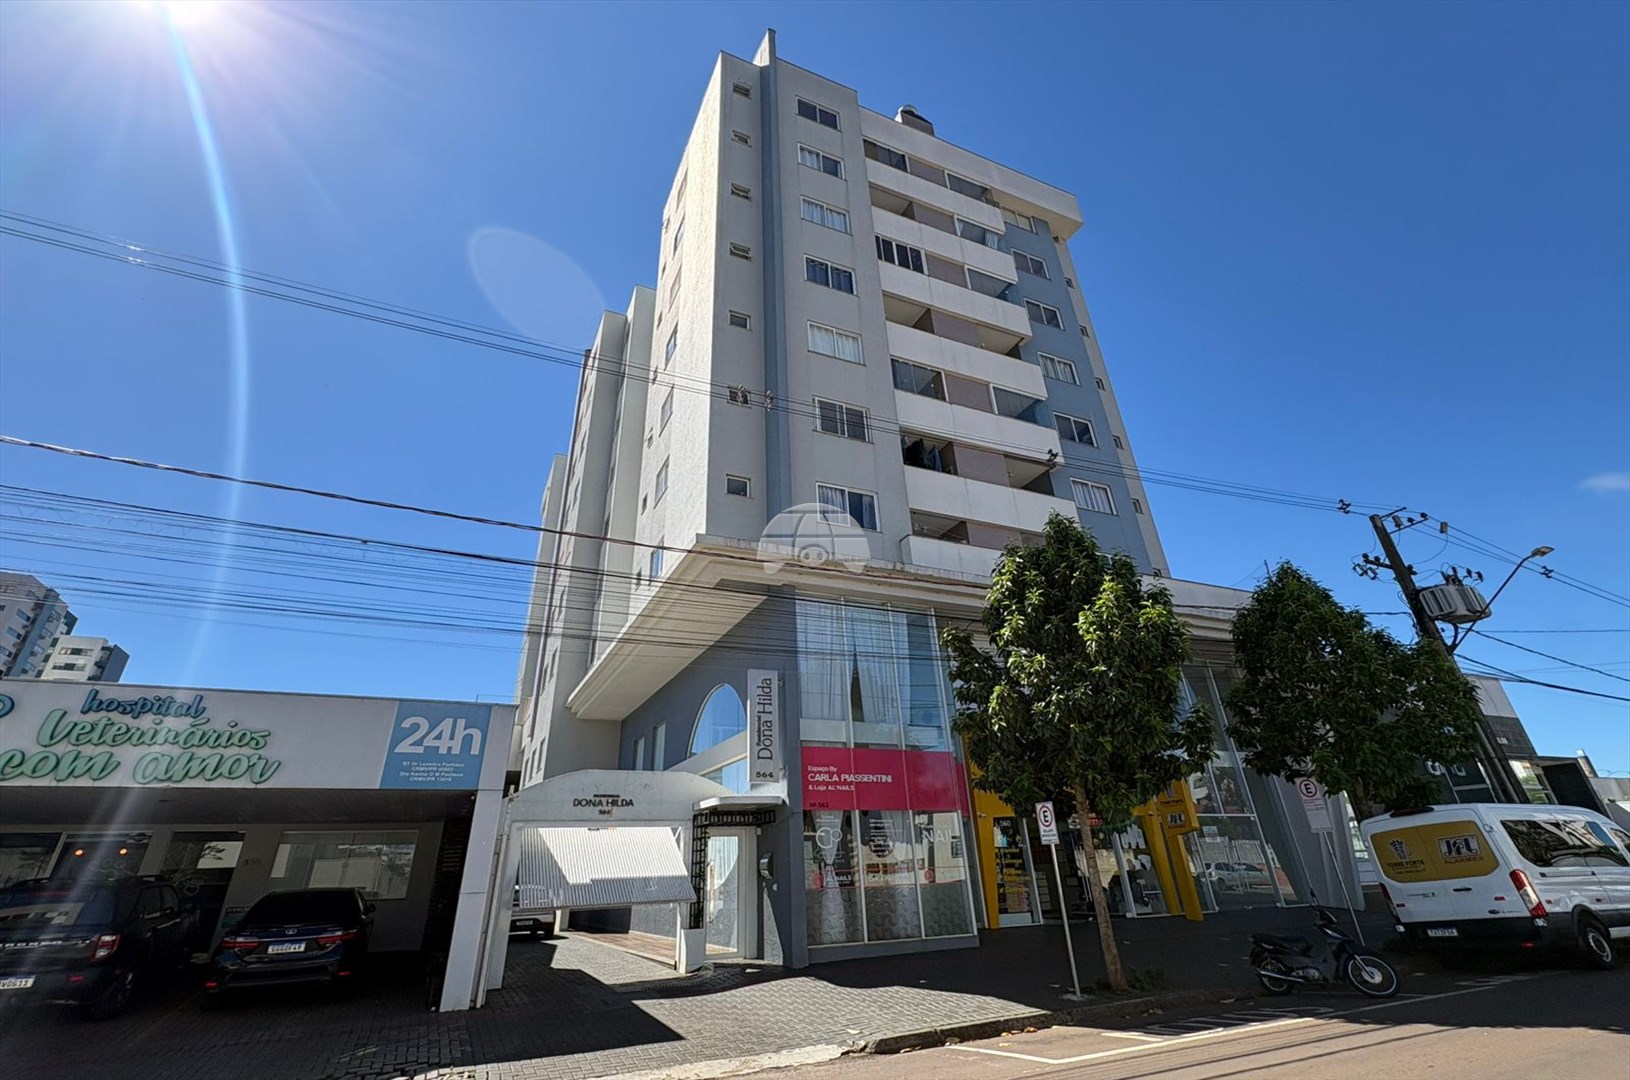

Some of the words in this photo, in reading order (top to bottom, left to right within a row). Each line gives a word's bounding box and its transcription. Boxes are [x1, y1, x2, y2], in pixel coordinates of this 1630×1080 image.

[80, 688, 208, 719] hospital
[756, 678, 773, 714] Hilda
[36, 708, 272, 749] Veterinários
[394, 716, 482, 755] 24h
[757, 720, 773, 760] Dona
[0, 749, 121, 782] com
[132, 750, 282, 785] amor
[755, 771, 774, 779] 564
[807, 765, 829, 773] Espaço
[807, 773, 839, 782] CARLA
[840, 773, 893, 783] PIASSENTINI
[1304, 783, 1313, 794] E
[572, 798, 603, 807] DONA
[606, 799, 634, 807] HILDA
[1042, 810, 1049, 823] E
